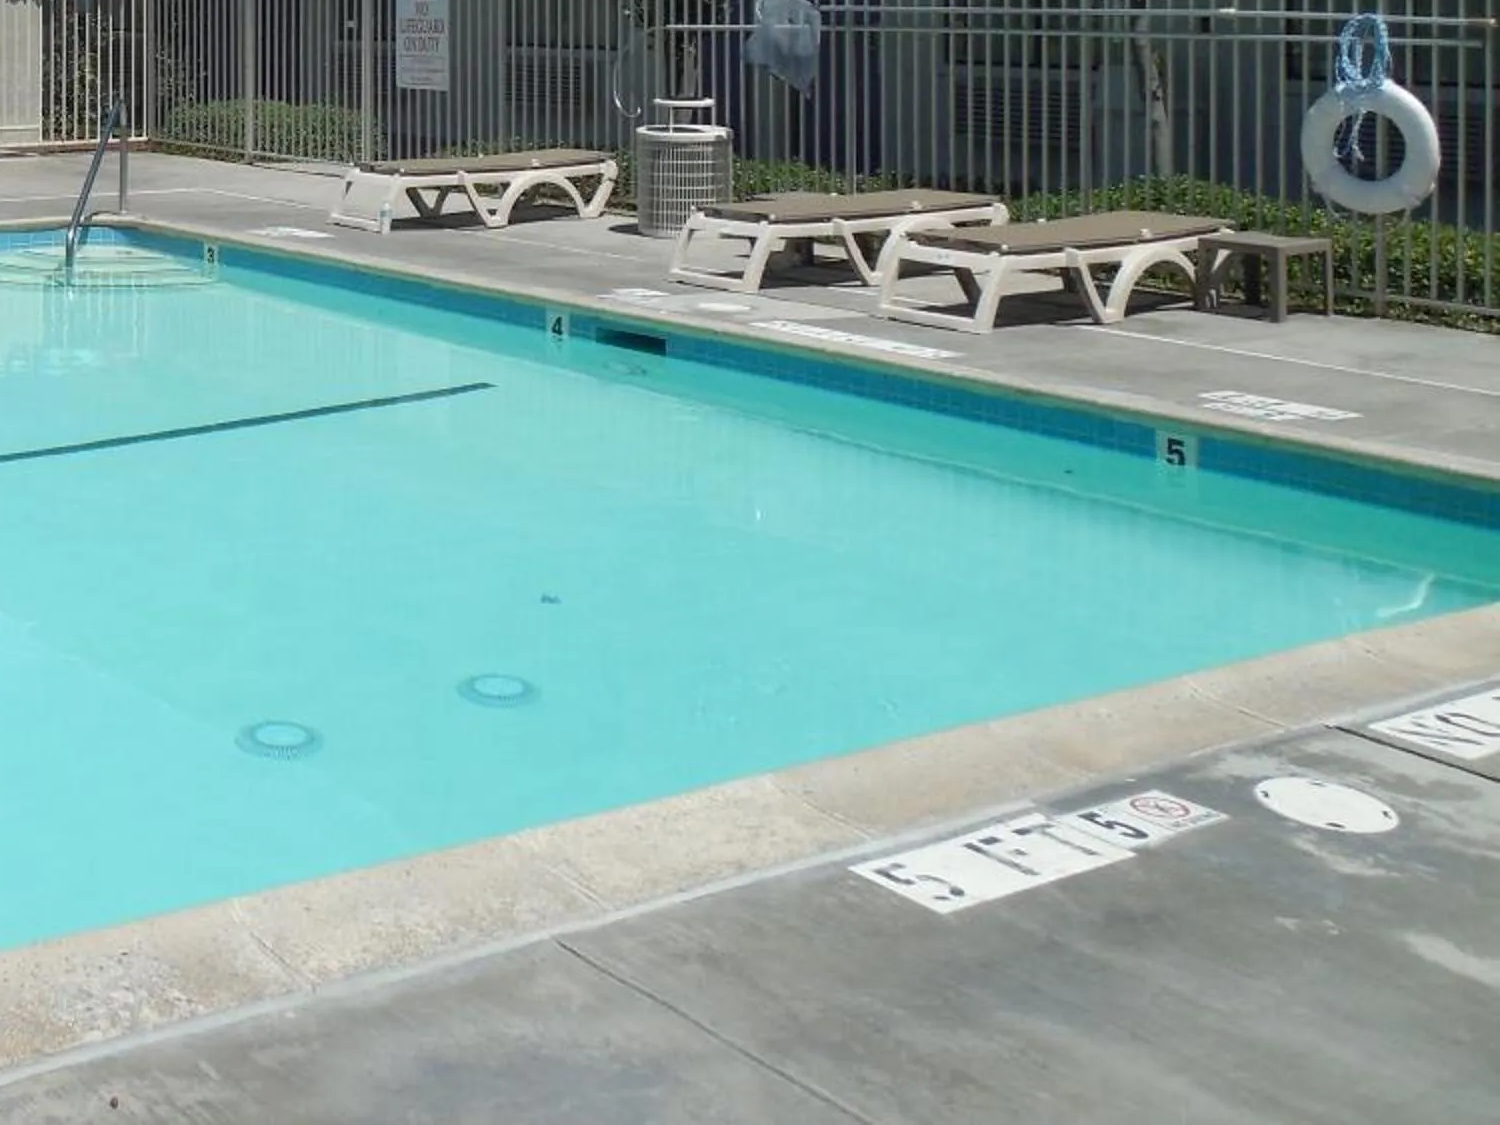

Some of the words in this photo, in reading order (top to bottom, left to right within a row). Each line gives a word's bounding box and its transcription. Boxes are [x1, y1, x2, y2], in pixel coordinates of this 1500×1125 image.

[551, 316, 563, 336] 4
[1166, 437, 1186, 466] 5
[1075, 810, 1151, 841] 5
[874, 861, 966, 901] 5
[963, 821, 1099, 876] FT
